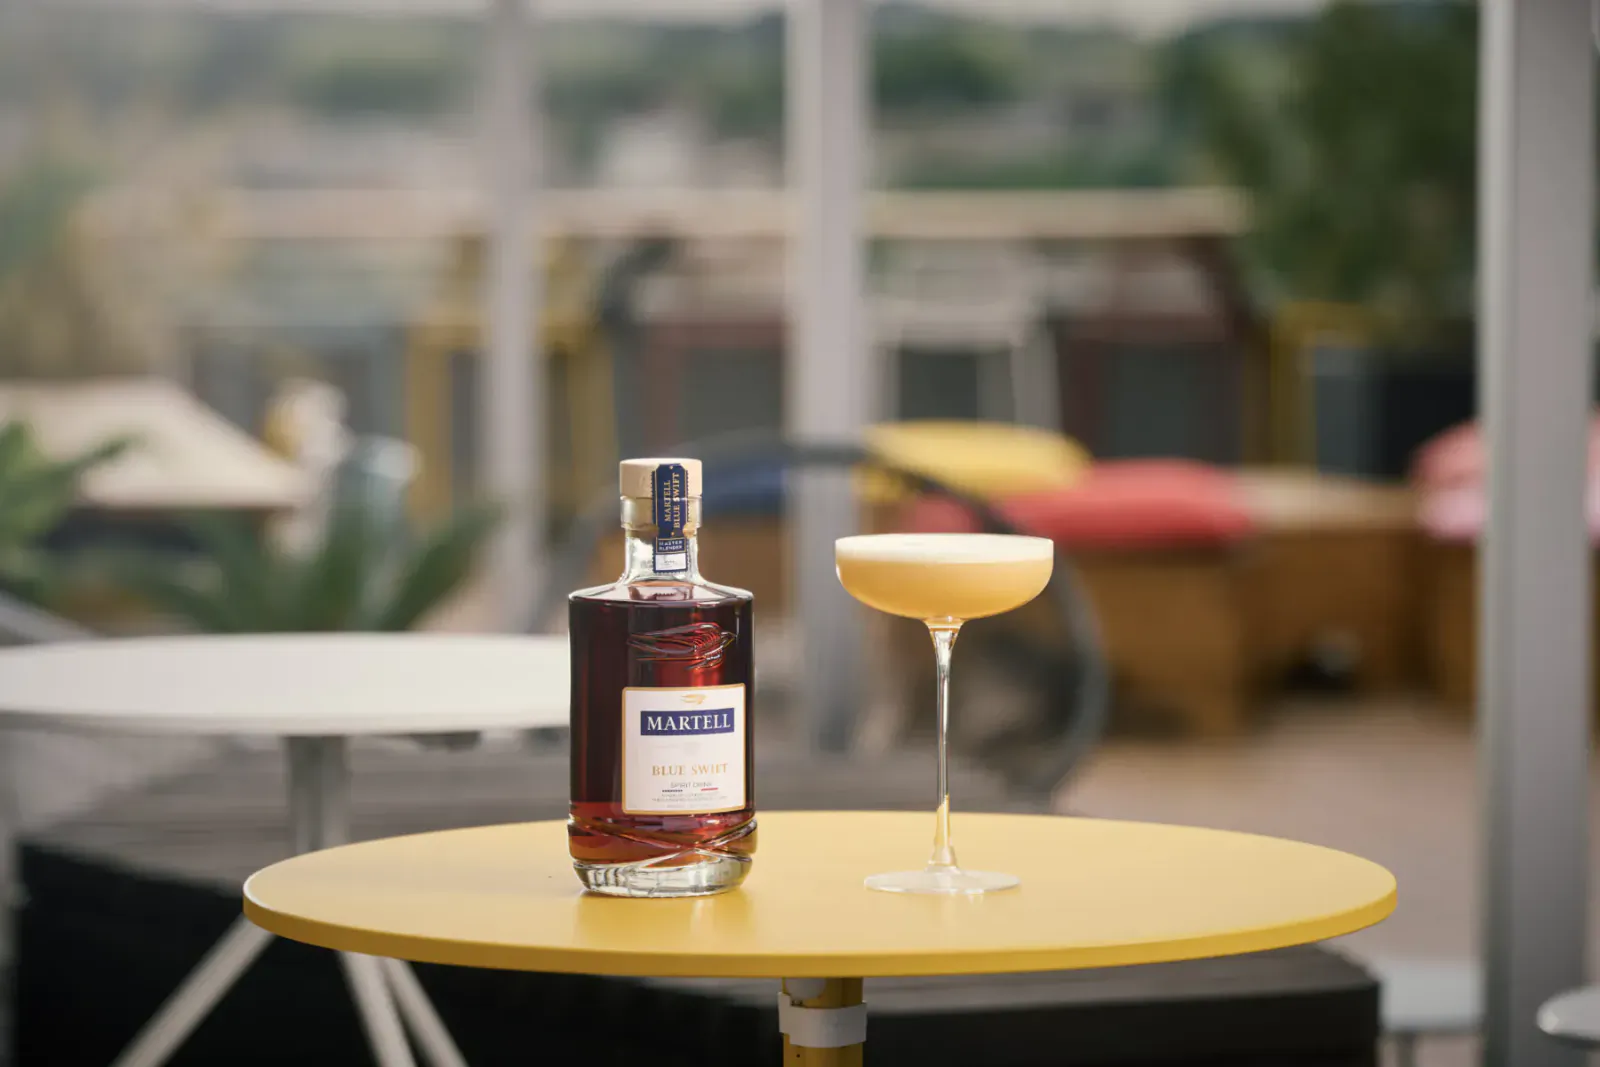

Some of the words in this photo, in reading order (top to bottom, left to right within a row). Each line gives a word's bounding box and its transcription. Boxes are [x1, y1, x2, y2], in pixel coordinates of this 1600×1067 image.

[672, 472, 680, 502] SWIFT
[663, 480, 672, 522] MARTELL
[673, 505, 681, 529] BLUE
[647, 713, 731, 731] MARTELL
[652, 765, 685, 776] BLUE
[692, 763, 728, 775] SWIFT
